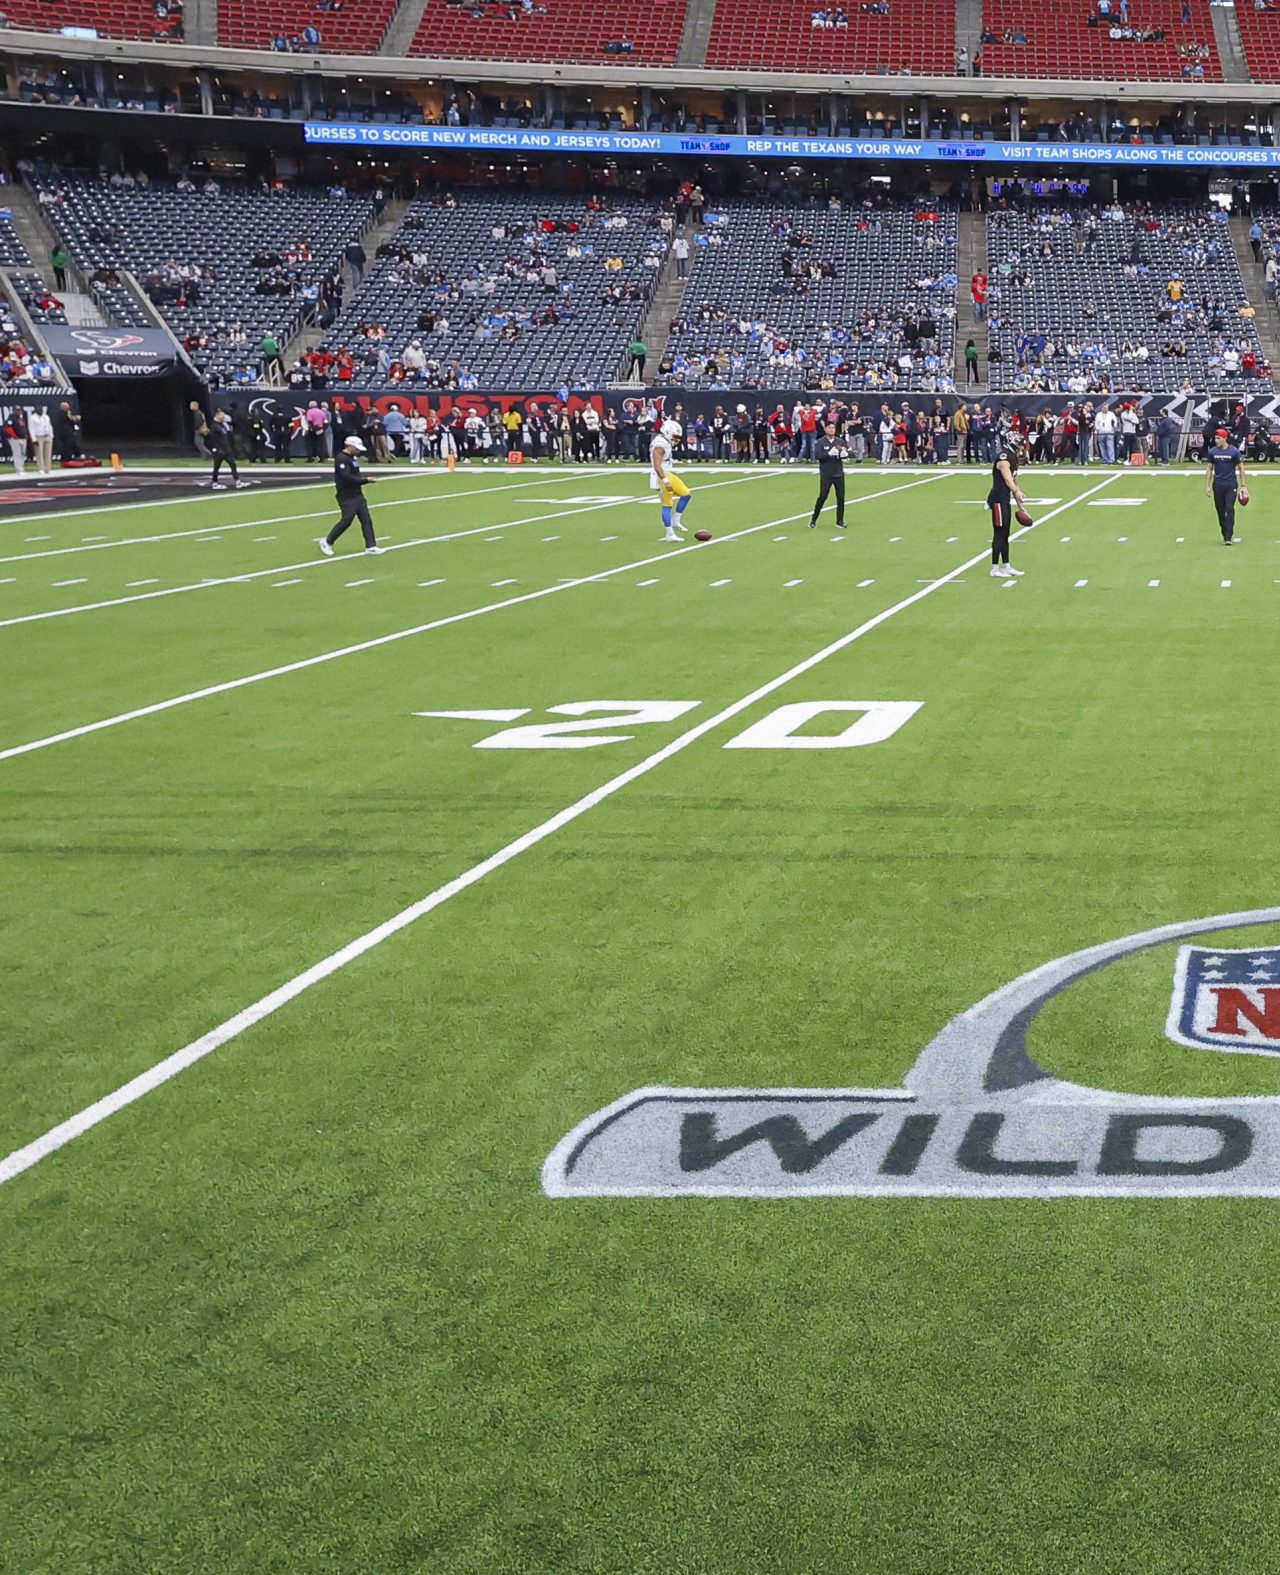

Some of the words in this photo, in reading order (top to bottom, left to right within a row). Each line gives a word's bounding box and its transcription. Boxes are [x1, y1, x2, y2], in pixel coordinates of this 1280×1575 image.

[359, 128, 379, 140] TO
[382, 130, 429, 142] SCORE
[433, 132, 466, 143] NEW
[469, 133, 517, 145] MERCH
[520, 134, 550, 146] AND
[553, 136, 610, 148] JERSEYS
[612, 137, 661, 149] TODAY!
[681, 141, 701, 150] TEAM
[710, 142, 730, 151] SHOP
[746, 140, 771, 152] REP
[774, 141, 800, 153] THE
[802, 142, 853, 154] TEXANS
[855, 143, 891, 155] YOUR
[893, 145, 921, 156] WAY
[1002, 147, 1033, 158] VISIT
[1035, 147, 1069, 158] TEAM
[1072, 148, 1113, 160] SHOPS
[1115, 149, 1158, 161] ALONG
[1160, 149, 1184, 161] THE
[1187, 150, 1268, 162] CONCOURSES
[103, 362, 160, 374] Chevron
[679, 1111, 1254, 1177] WILD
